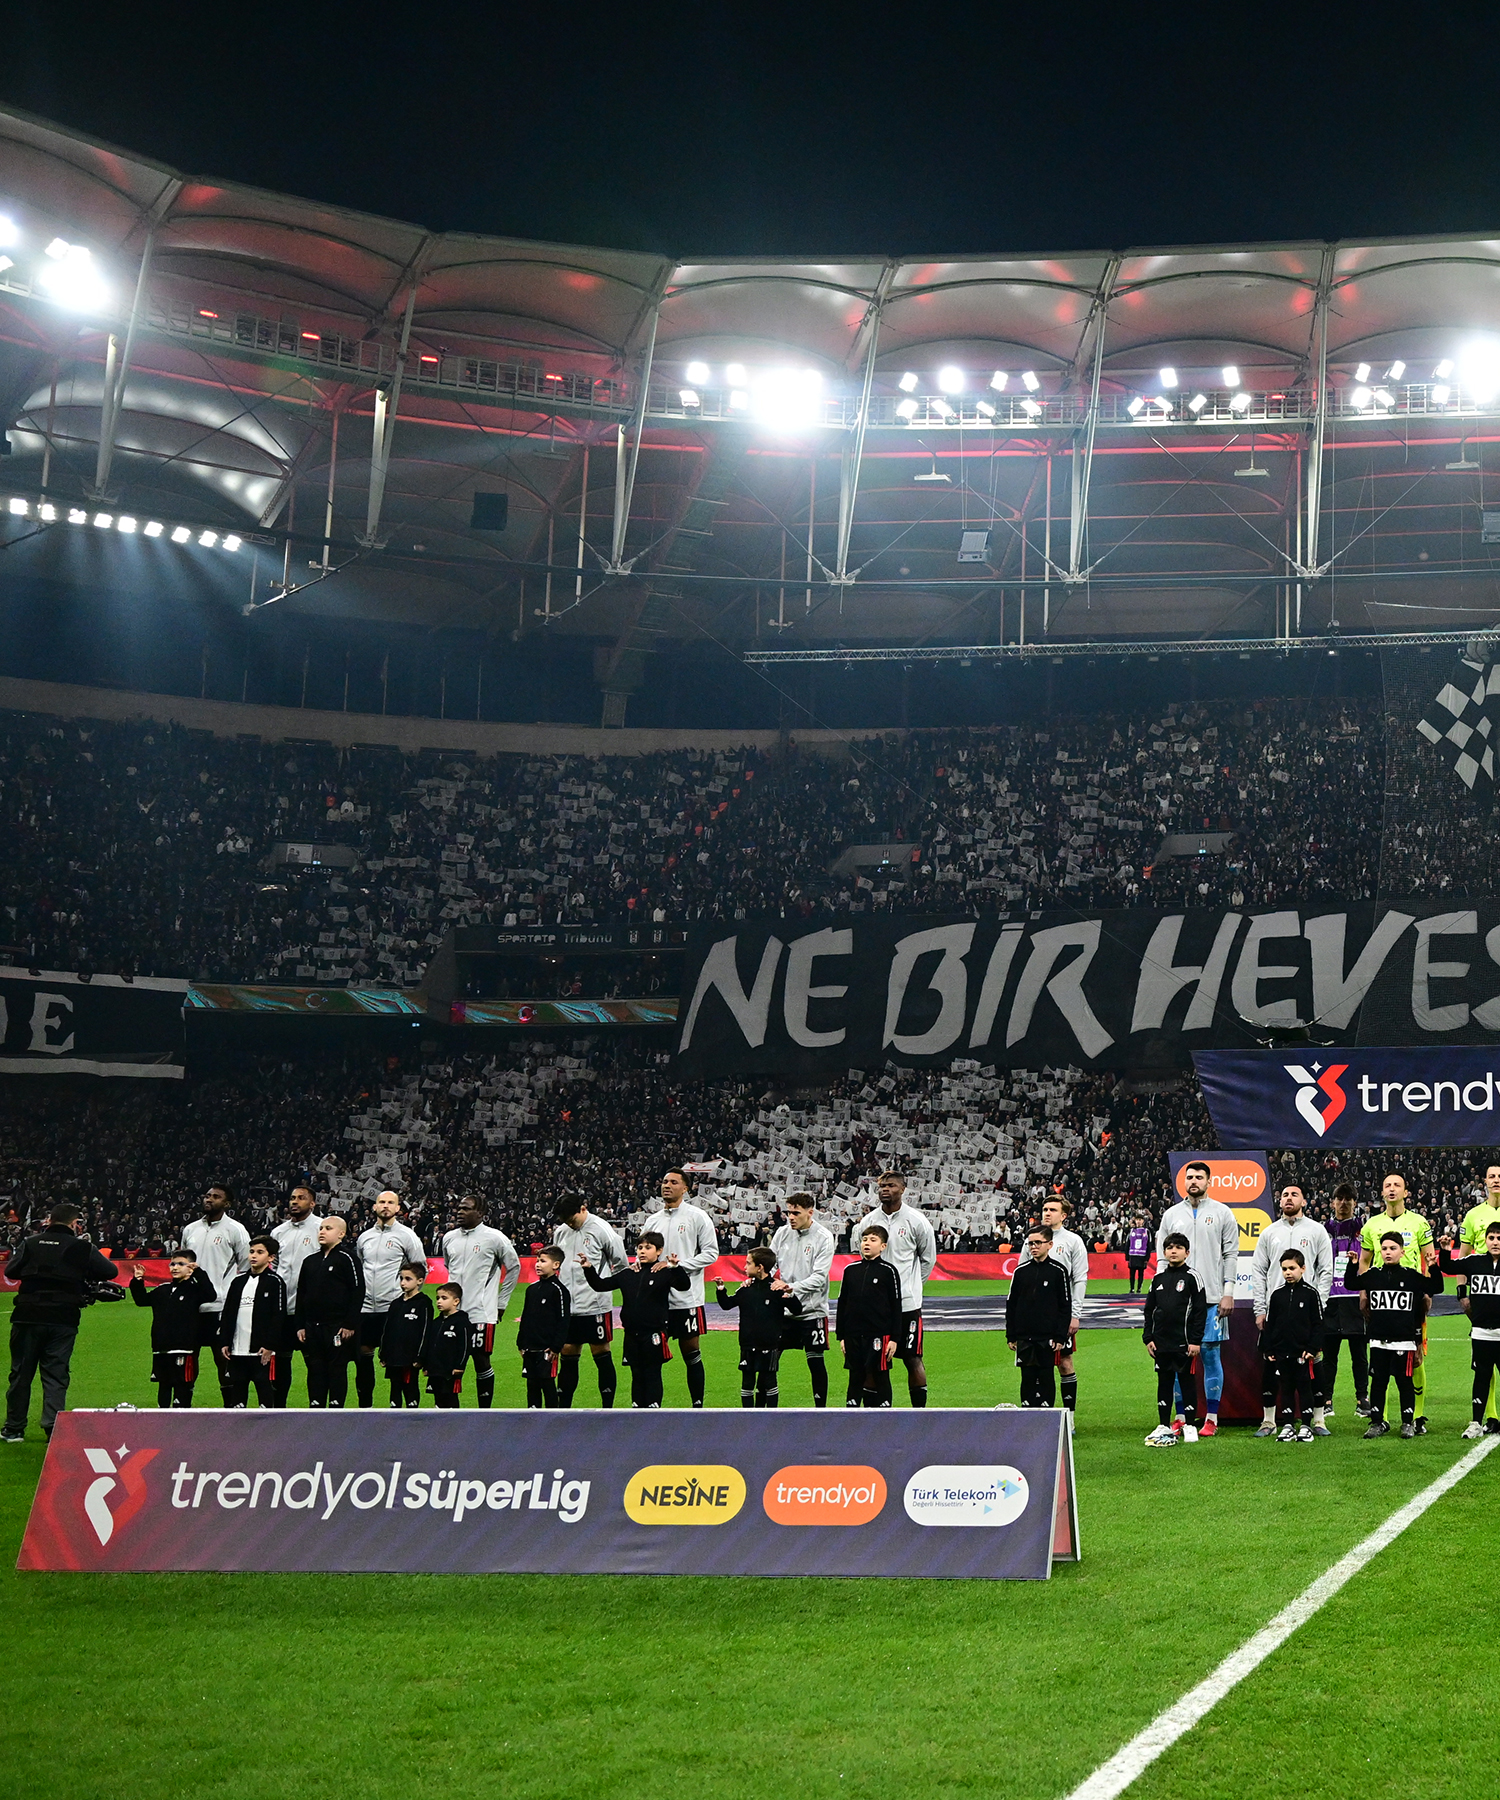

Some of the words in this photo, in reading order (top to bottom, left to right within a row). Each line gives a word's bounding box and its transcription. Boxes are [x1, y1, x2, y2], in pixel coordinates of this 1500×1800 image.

[564, 933, 612, 943] Tribünü
[678, 926, 852, 1056] NE
[1209, 1172, 1258, 1190] ndyol
[1370, 1291, 1413, 1311] SAYGI
[597, 1325, 605, 1339] 9
[685, 1317, 698, 1333] 14
[471, 1332, 484, 1348] 15
[812, 1330, 825, 1345] 23
[171, 1461, 401, 1520] trendyol
[403, 1469, 591, 1524] SüperLig
[776, 1482, 876, 1509] trendyol
[912, 1488, 940, 1501] Türk
[944, 1488, 997, 1501] Telekom
